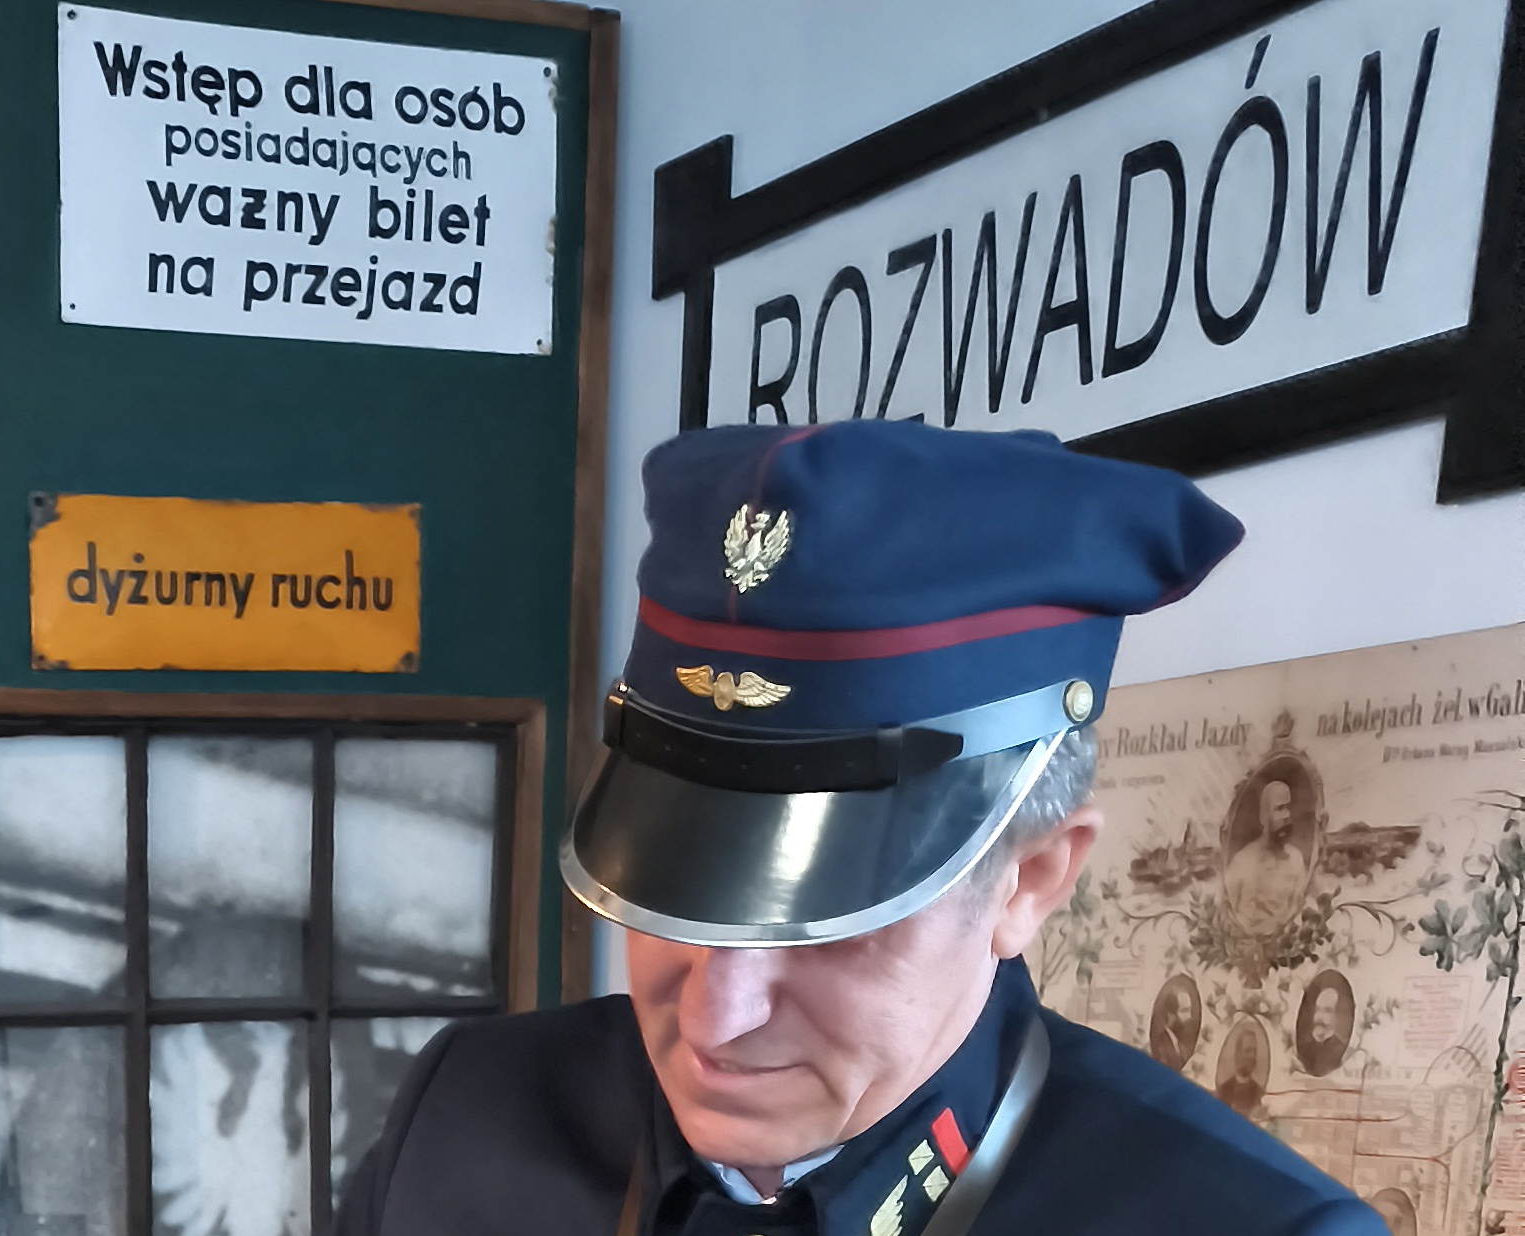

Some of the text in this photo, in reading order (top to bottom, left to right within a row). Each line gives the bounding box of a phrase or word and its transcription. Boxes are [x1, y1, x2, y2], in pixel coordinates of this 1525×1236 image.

[93, 41, 525, 135] Wstęp dla osób
[165, 122, 472, 184] posiadających
[368, 186, 491, 246] bilet
[748, 27, 1441, 427] ROZWADÓW
[147, 253, 482, 319] na przejazd
[67, 542, 393, 619] dyżurny ruchu
